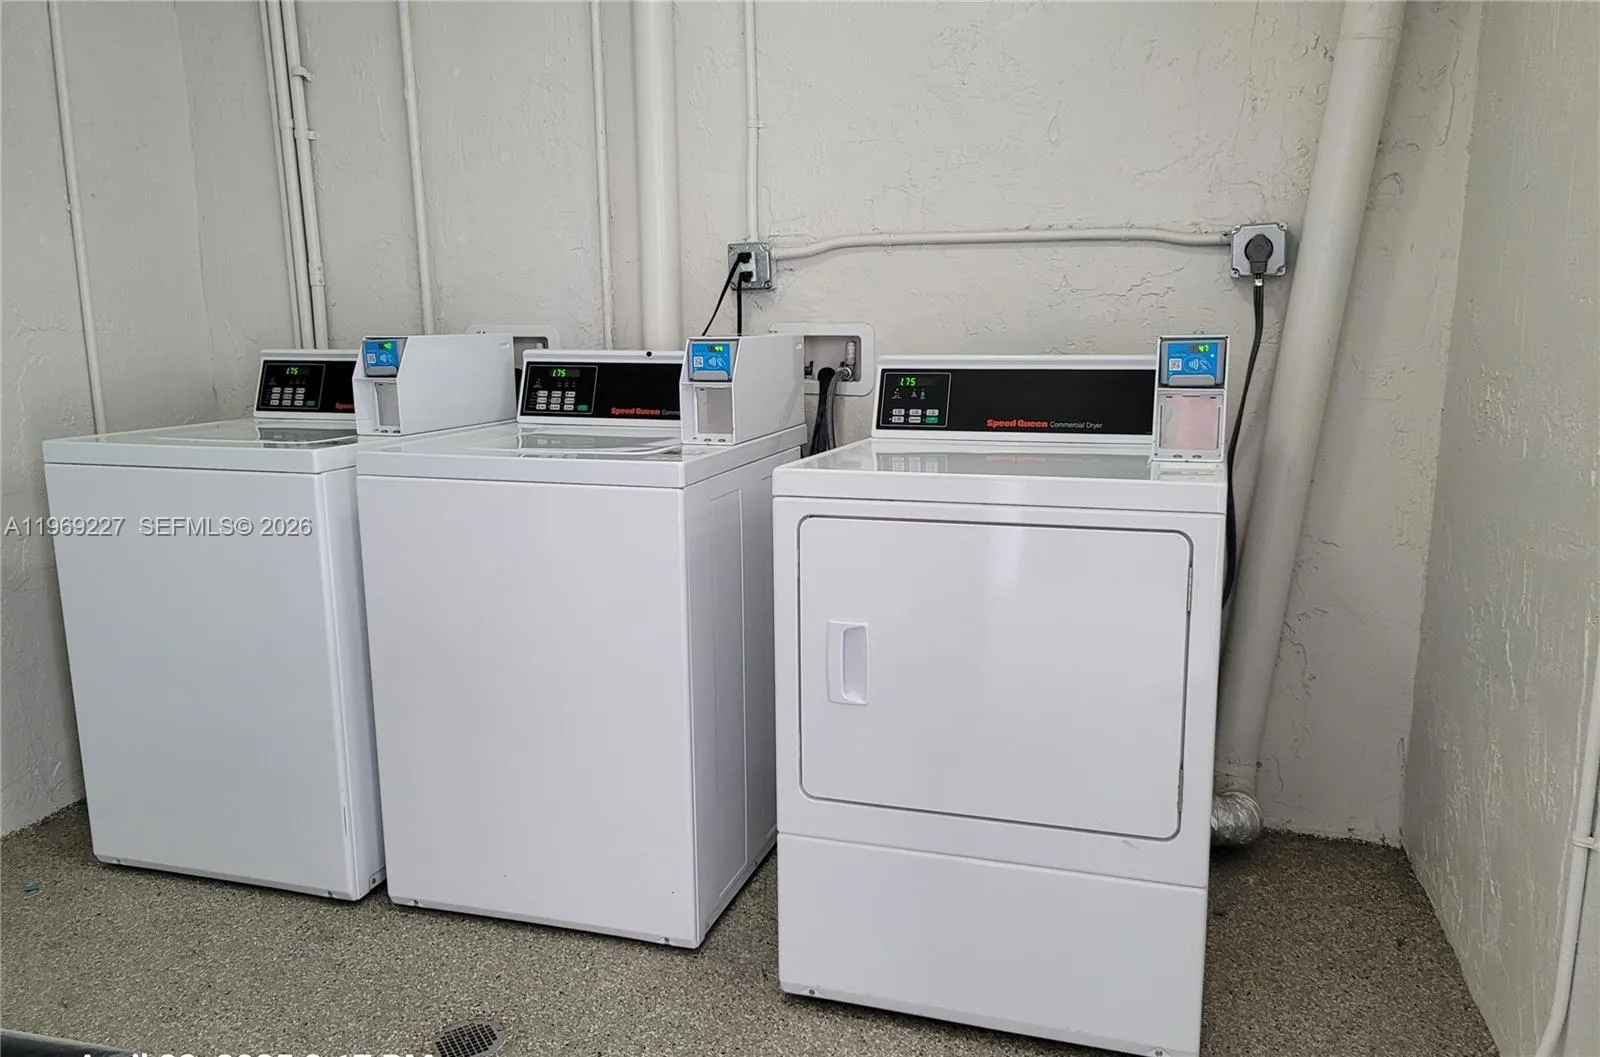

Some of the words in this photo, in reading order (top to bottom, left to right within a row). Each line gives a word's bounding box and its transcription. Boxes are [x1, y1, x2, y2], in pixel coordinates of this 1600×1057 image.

[611, 407, 635, 416] Speed
[636, 408, 660, 416] Queen
[986, 418, 1016, 429] Speed
[1017, 419, 1048, 428] Queen
[1049, 420, 1085, 429] Commercial
[1085, 421, 1103, 430] Dryer
